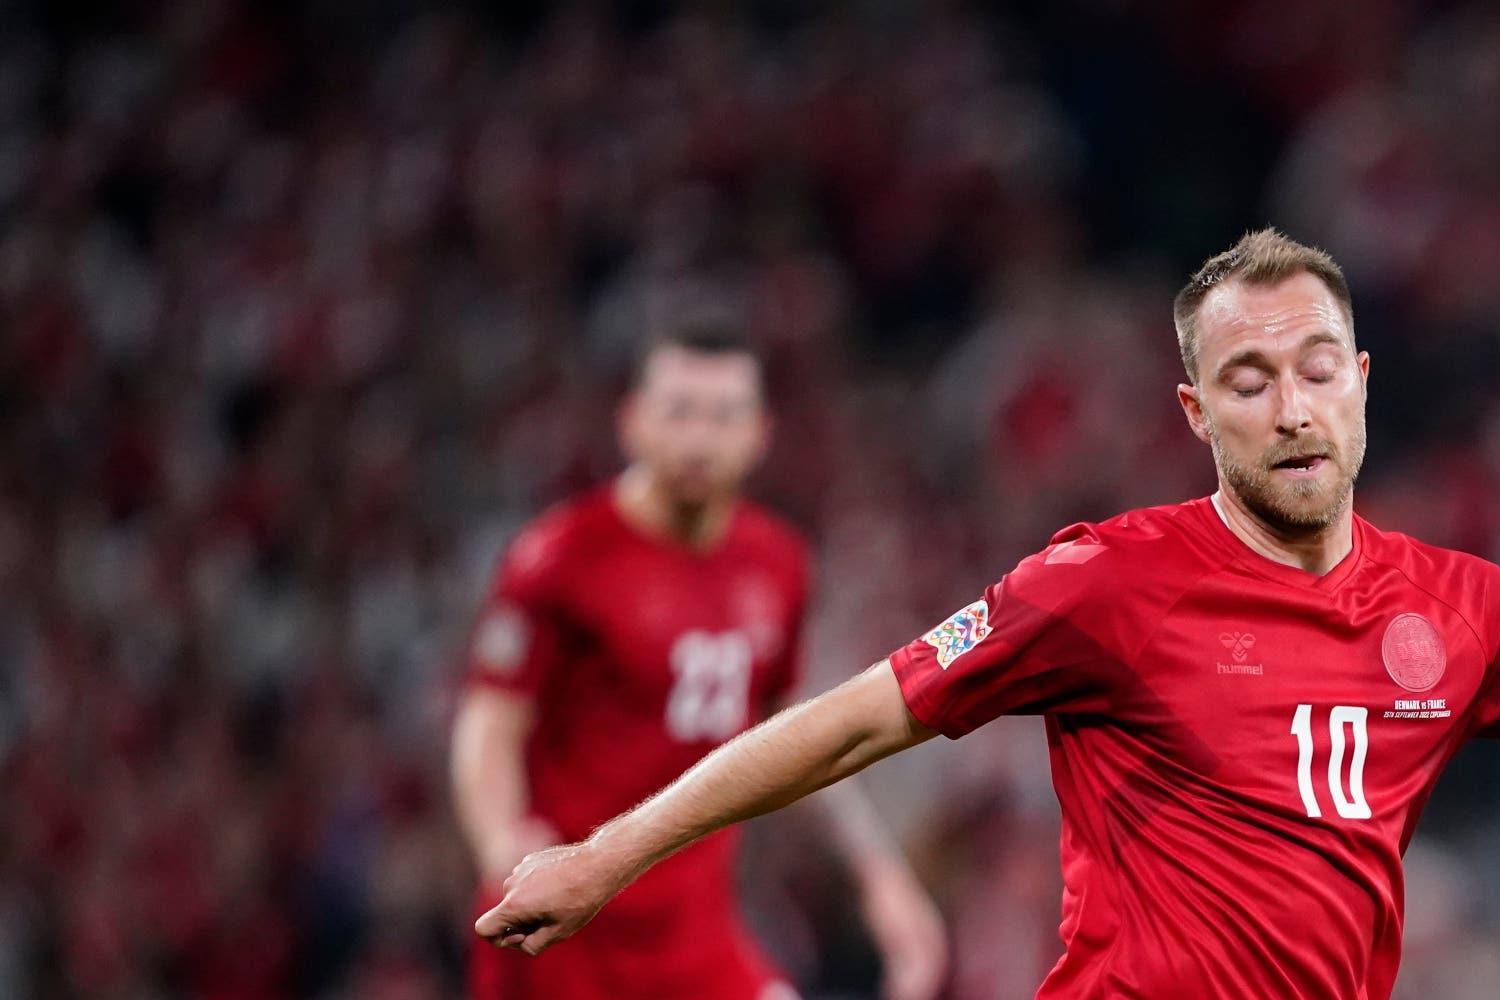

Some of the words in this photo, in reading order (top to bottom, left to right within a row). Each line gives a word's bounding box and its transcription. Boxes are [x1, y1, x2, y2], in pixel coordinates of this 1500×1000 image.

[1217, 662, 1263, 676] hummel
[1394, 700, 1420, 710] DENMARK
[1427, 699, 1446, 709] FRANCE
[1290, 704, 1372, 819] 10
